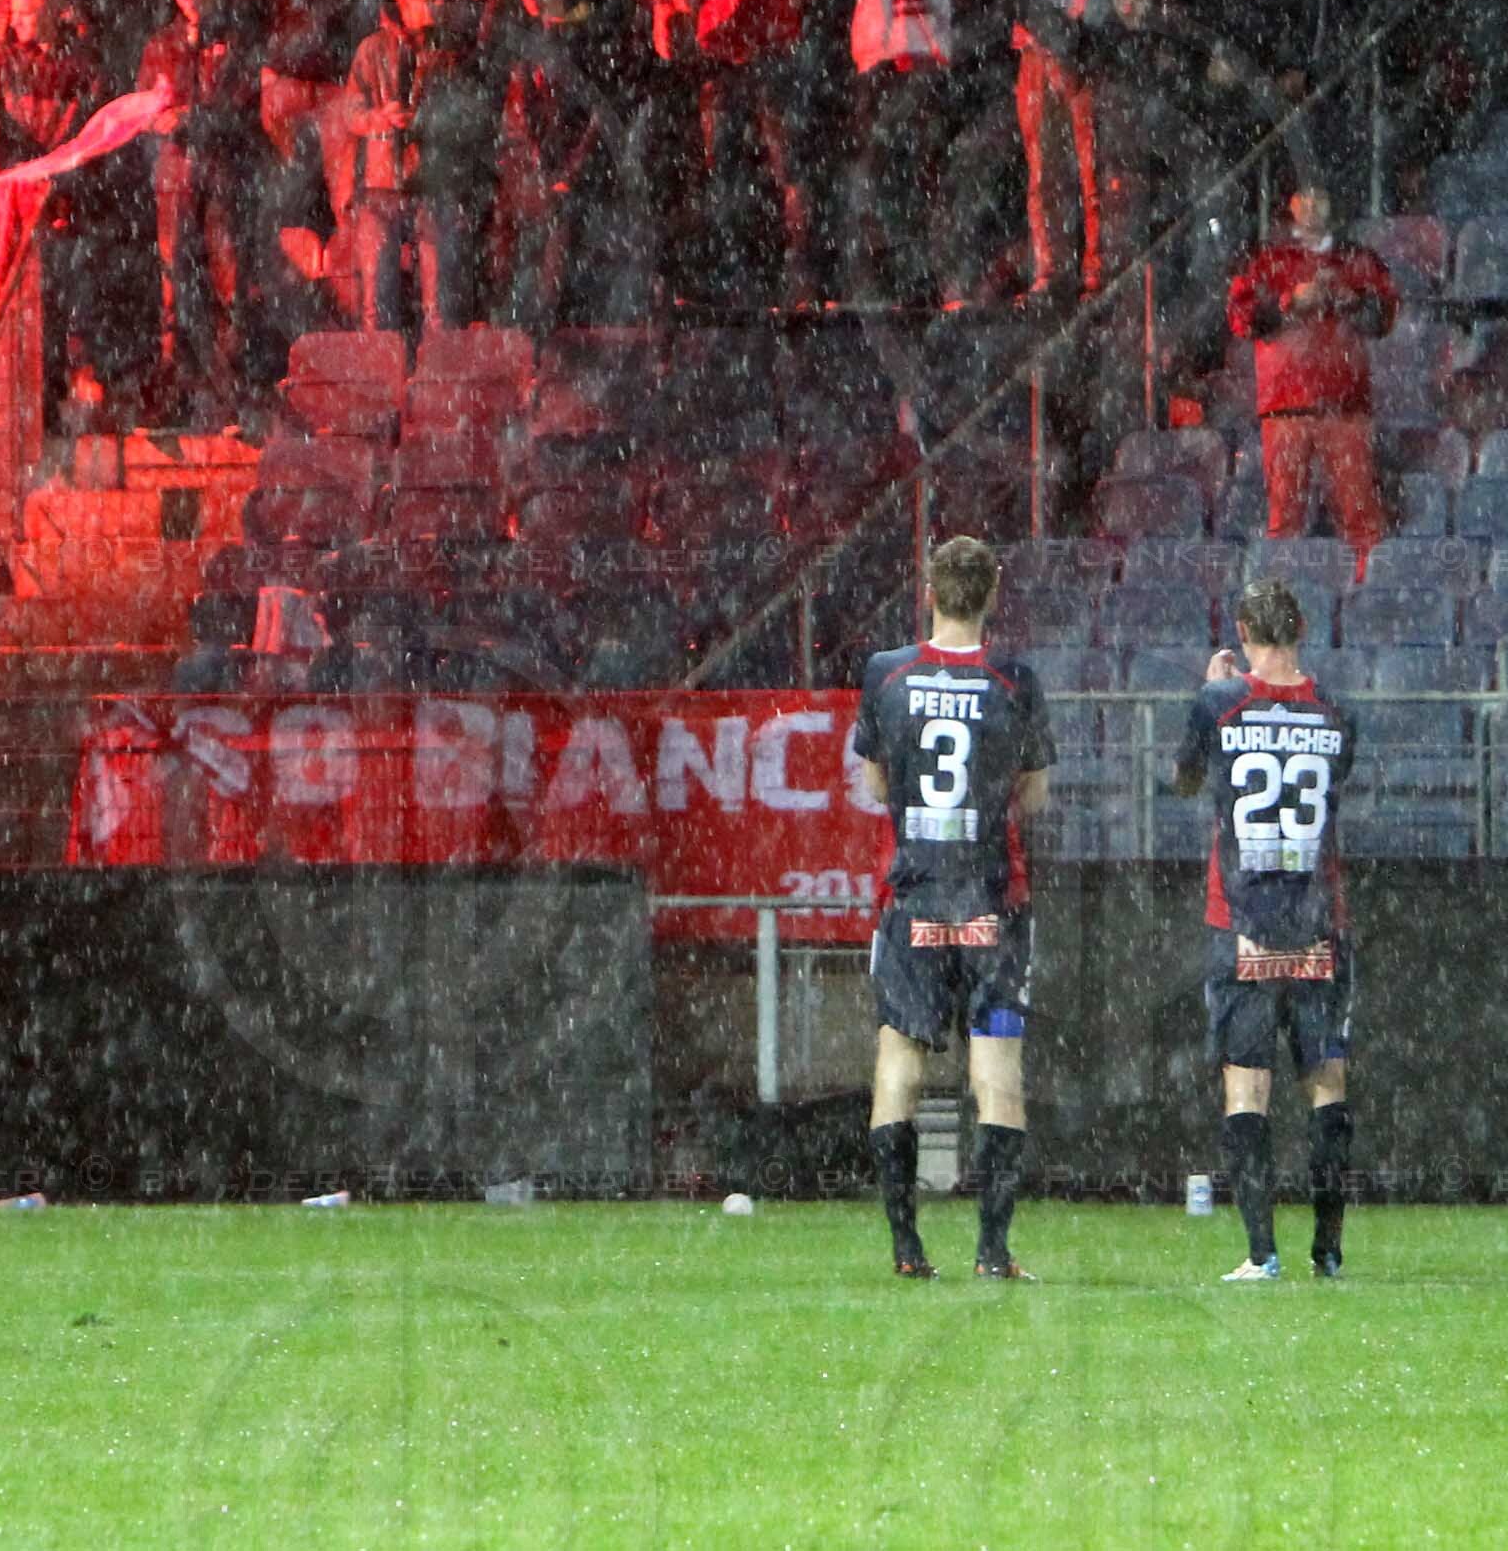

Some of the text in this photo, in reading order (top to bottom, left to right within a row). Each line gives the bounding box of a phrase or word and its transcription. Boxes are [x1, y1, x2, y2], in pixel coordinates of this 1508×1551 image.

[909, 690, 983, 720] PERTL
[920, 719, 971, 808] 3
[1221, 726, 1343, 755] DURLACHER
[1230, 752, 1331, 840] 23
